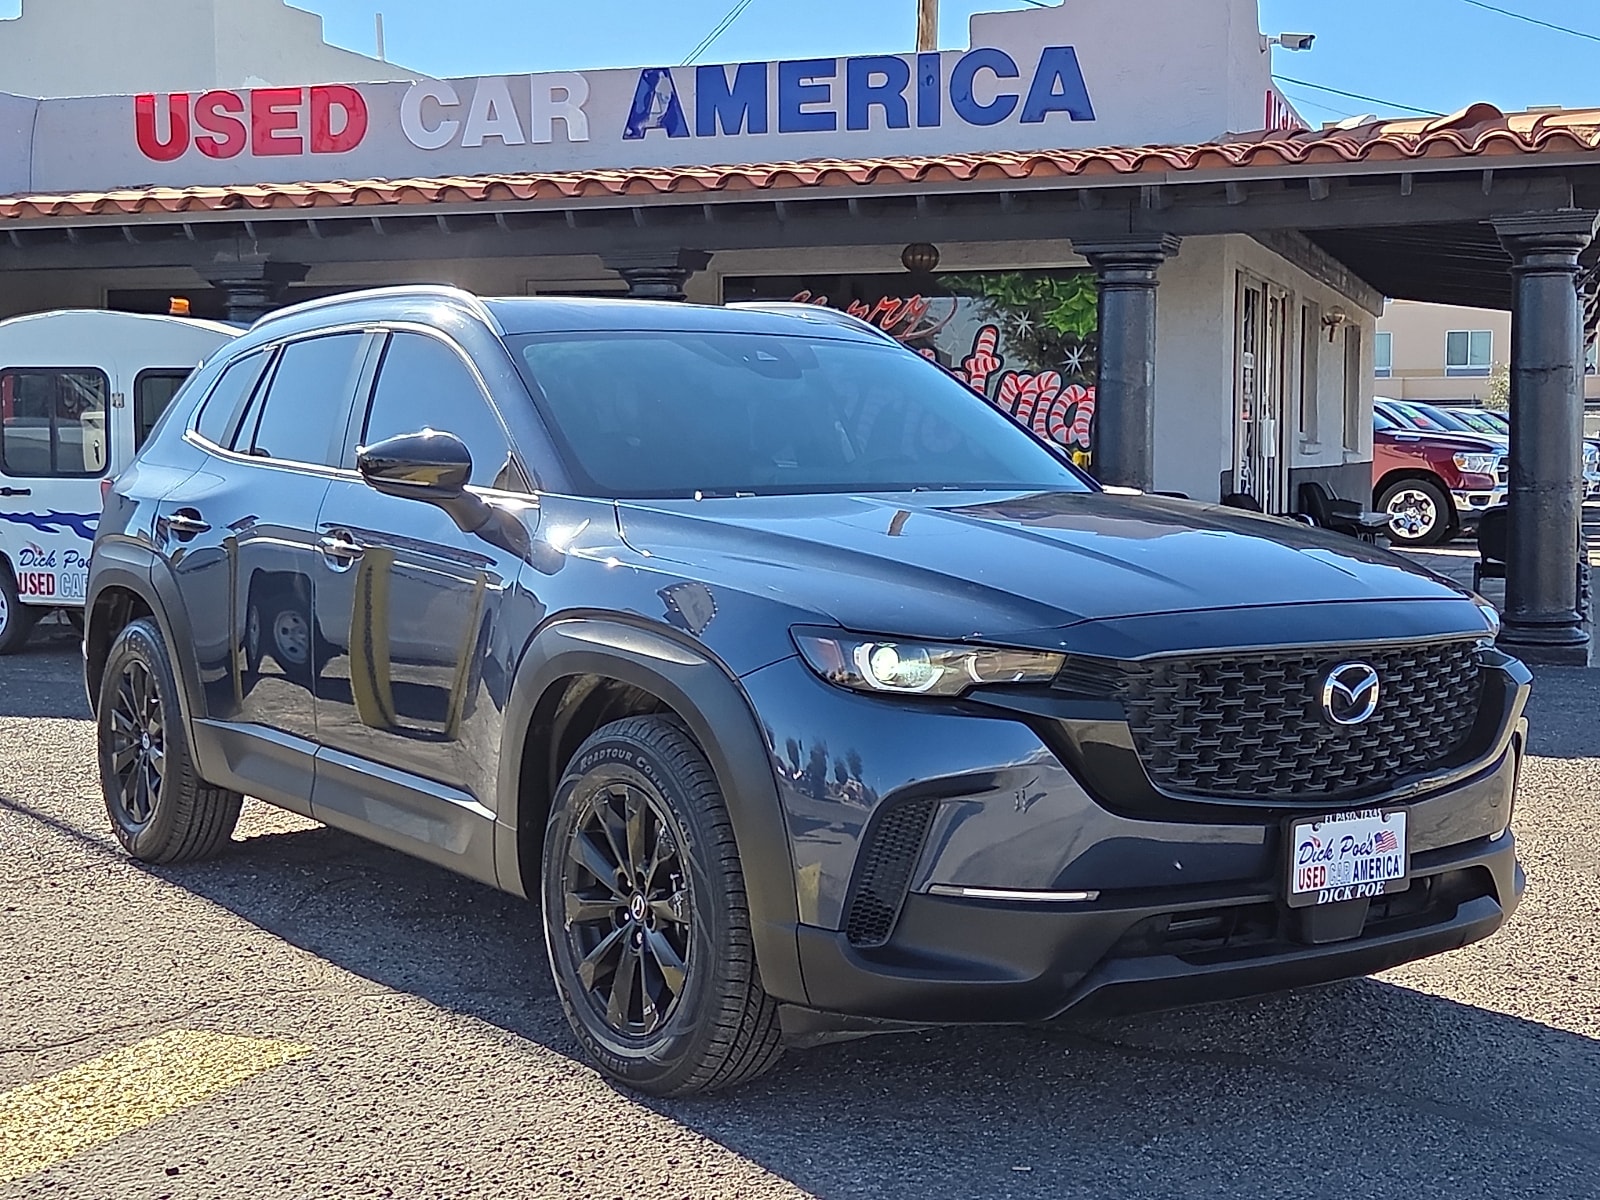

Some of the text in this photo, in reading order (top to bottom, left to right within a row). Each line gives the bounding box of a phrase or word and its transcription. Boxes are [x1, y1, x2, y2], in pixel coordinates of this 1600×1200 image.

[134, 45, 1097, 161] USED CAR AMERICA
[19, 548, 57, 568] Dick
[19, 572, 55, 595] USED
[1298, 832, 1374, 865] Dick Poe's
[1298, 855, 1400, 890] USED CAR AMERICA
[1316, 881, 1386, 905] DICK POE
